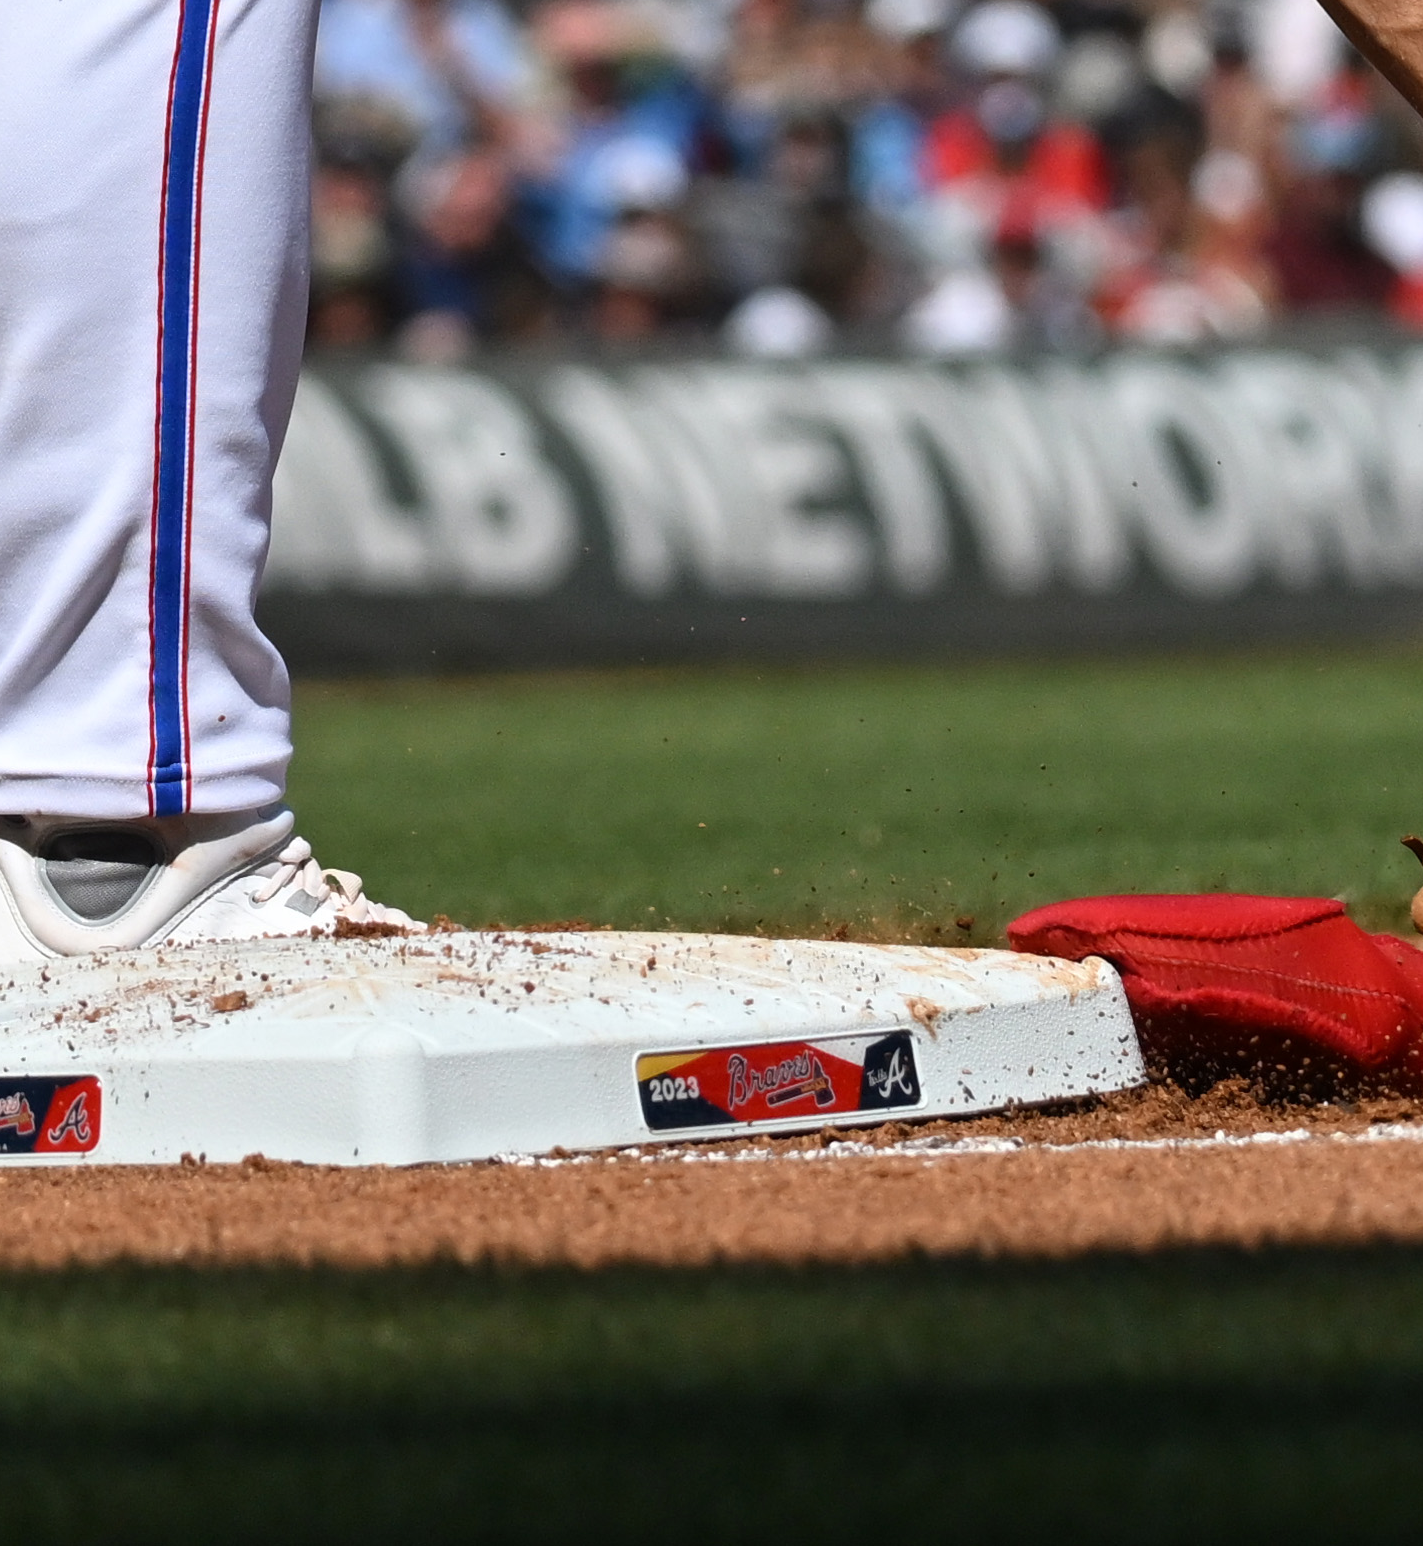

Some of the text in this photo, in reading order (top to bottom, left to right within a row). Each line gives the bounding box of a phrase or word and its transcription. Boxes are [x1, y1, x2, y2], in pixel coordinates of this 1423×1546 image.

[649, 1076, 700, 1102] 2023
[727, 1050, 812, 1111] Braves
[48, 1092, 90, 1143] A
